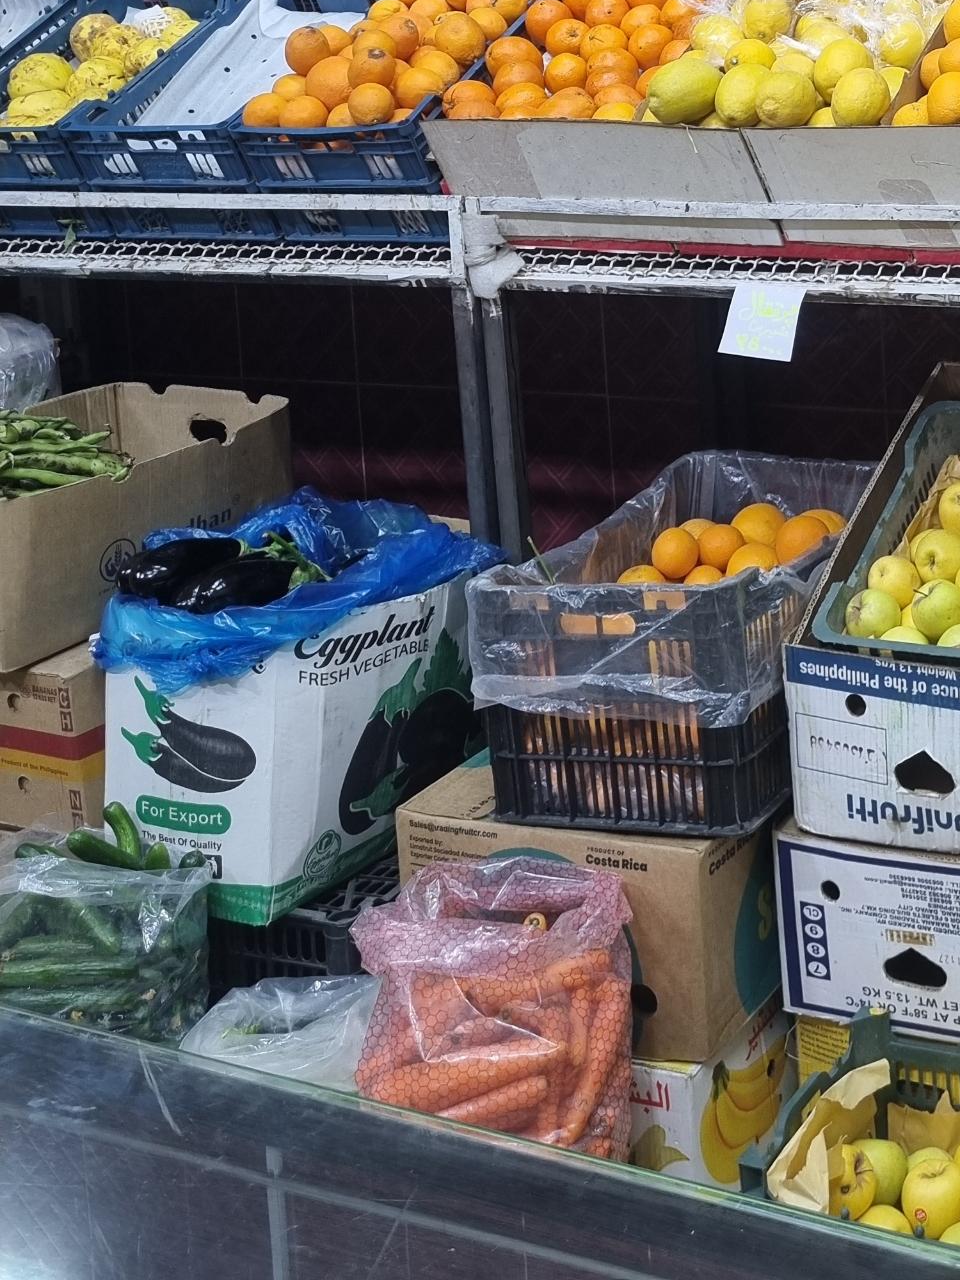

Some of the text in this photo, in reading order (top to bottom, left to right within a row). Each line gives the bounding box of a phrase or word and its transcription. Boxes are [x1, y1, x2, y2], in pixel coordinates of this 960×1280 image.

[293, 606, 436, 669] Eggplant
[298, 638, 429, 687] FRESH VEGETABLE
[798, 661, 880, 690] Philippines
[883, 675, 909, 694] the
[911, 681, 927, 698] of
[141, 800, 223, 827] For Export
[142, 830, 222, 852] The Best Of Quality
[586, 846, 615, 855] PRODUCT
[585, 854, 648, 872] Costa Rica
[708, 846, 737, 876] Costa
[862, 986, 881, 999] KG
[884, 989, 911, 1004] 13.5
[913, 995, 938, 1009] WT.
[932, 1011, 950, 1024] AT
